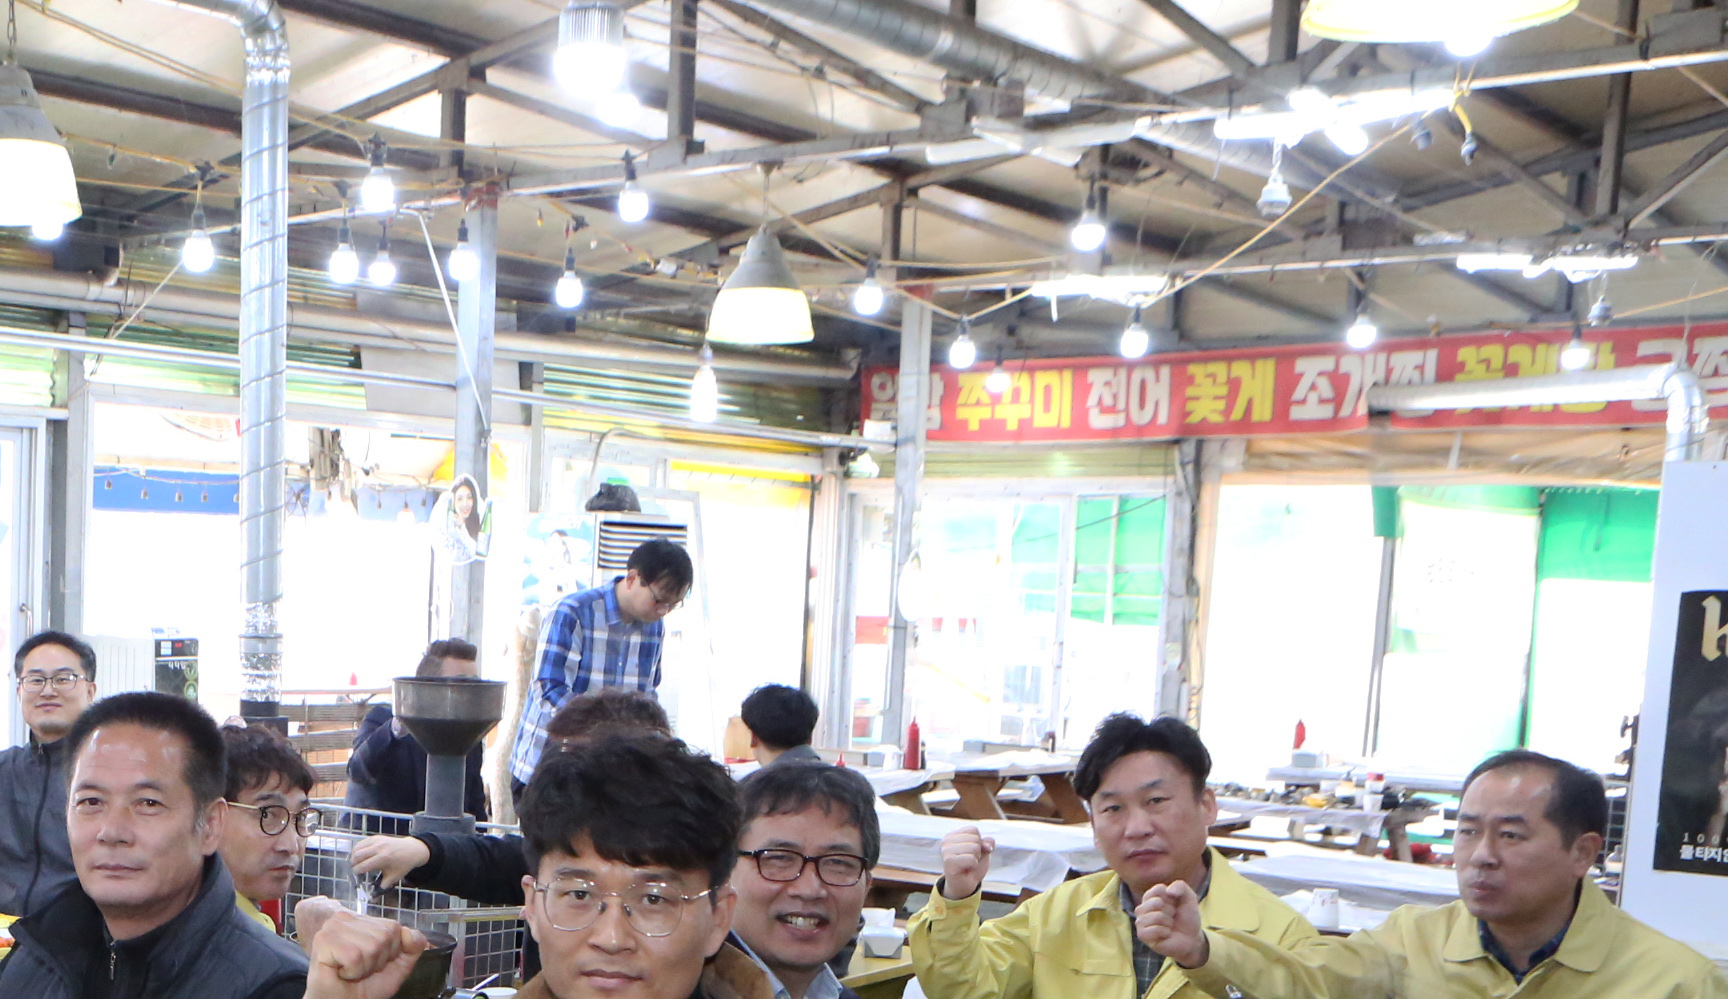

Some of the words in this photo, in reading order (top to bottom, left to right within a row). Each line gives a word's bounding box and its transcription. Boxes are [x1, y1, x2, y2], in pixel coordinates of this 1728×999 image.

[955, 368, 1072, 432] 쭈꾸미
[1086, 363, 1171, 430] 전어
[1184, 357, 1276, 424] 꽃게
